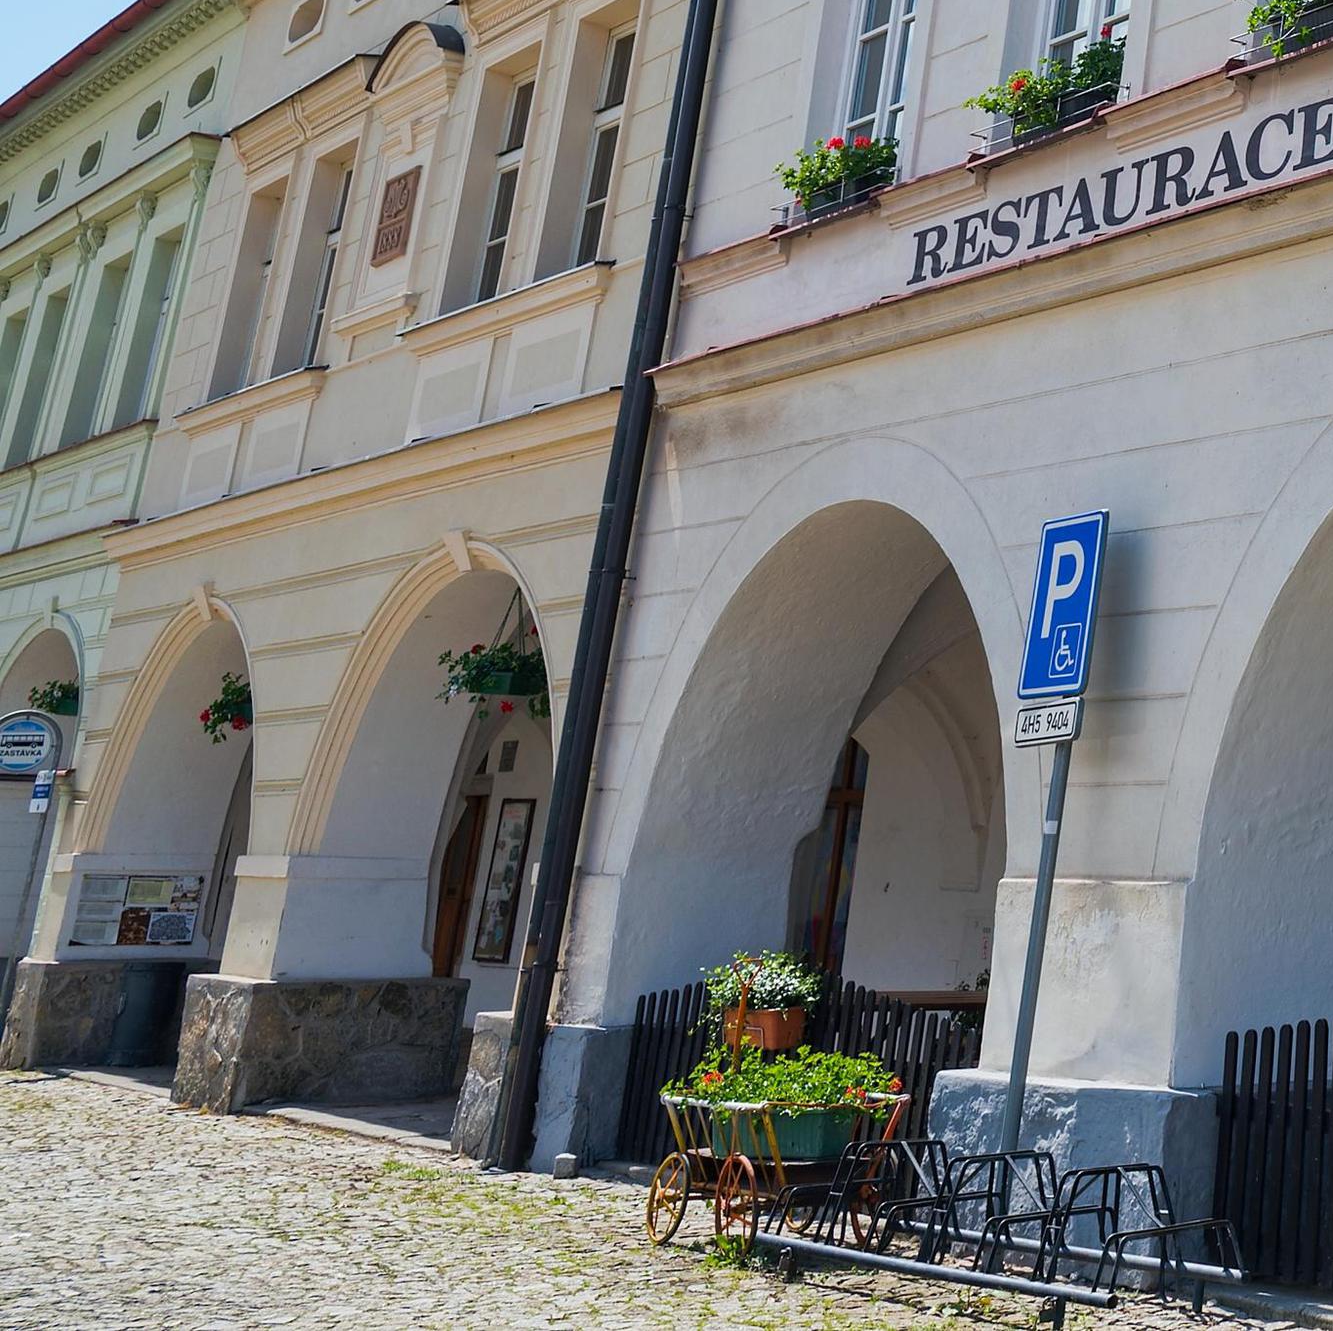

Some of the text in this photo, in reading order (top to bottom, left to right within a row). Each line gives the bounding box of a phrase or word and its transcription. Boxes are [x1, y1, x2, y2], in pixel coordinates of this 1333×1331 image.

[1040, 539, 1085, 639] P
[1021, 709, 1069, 736] 4H5 9404
